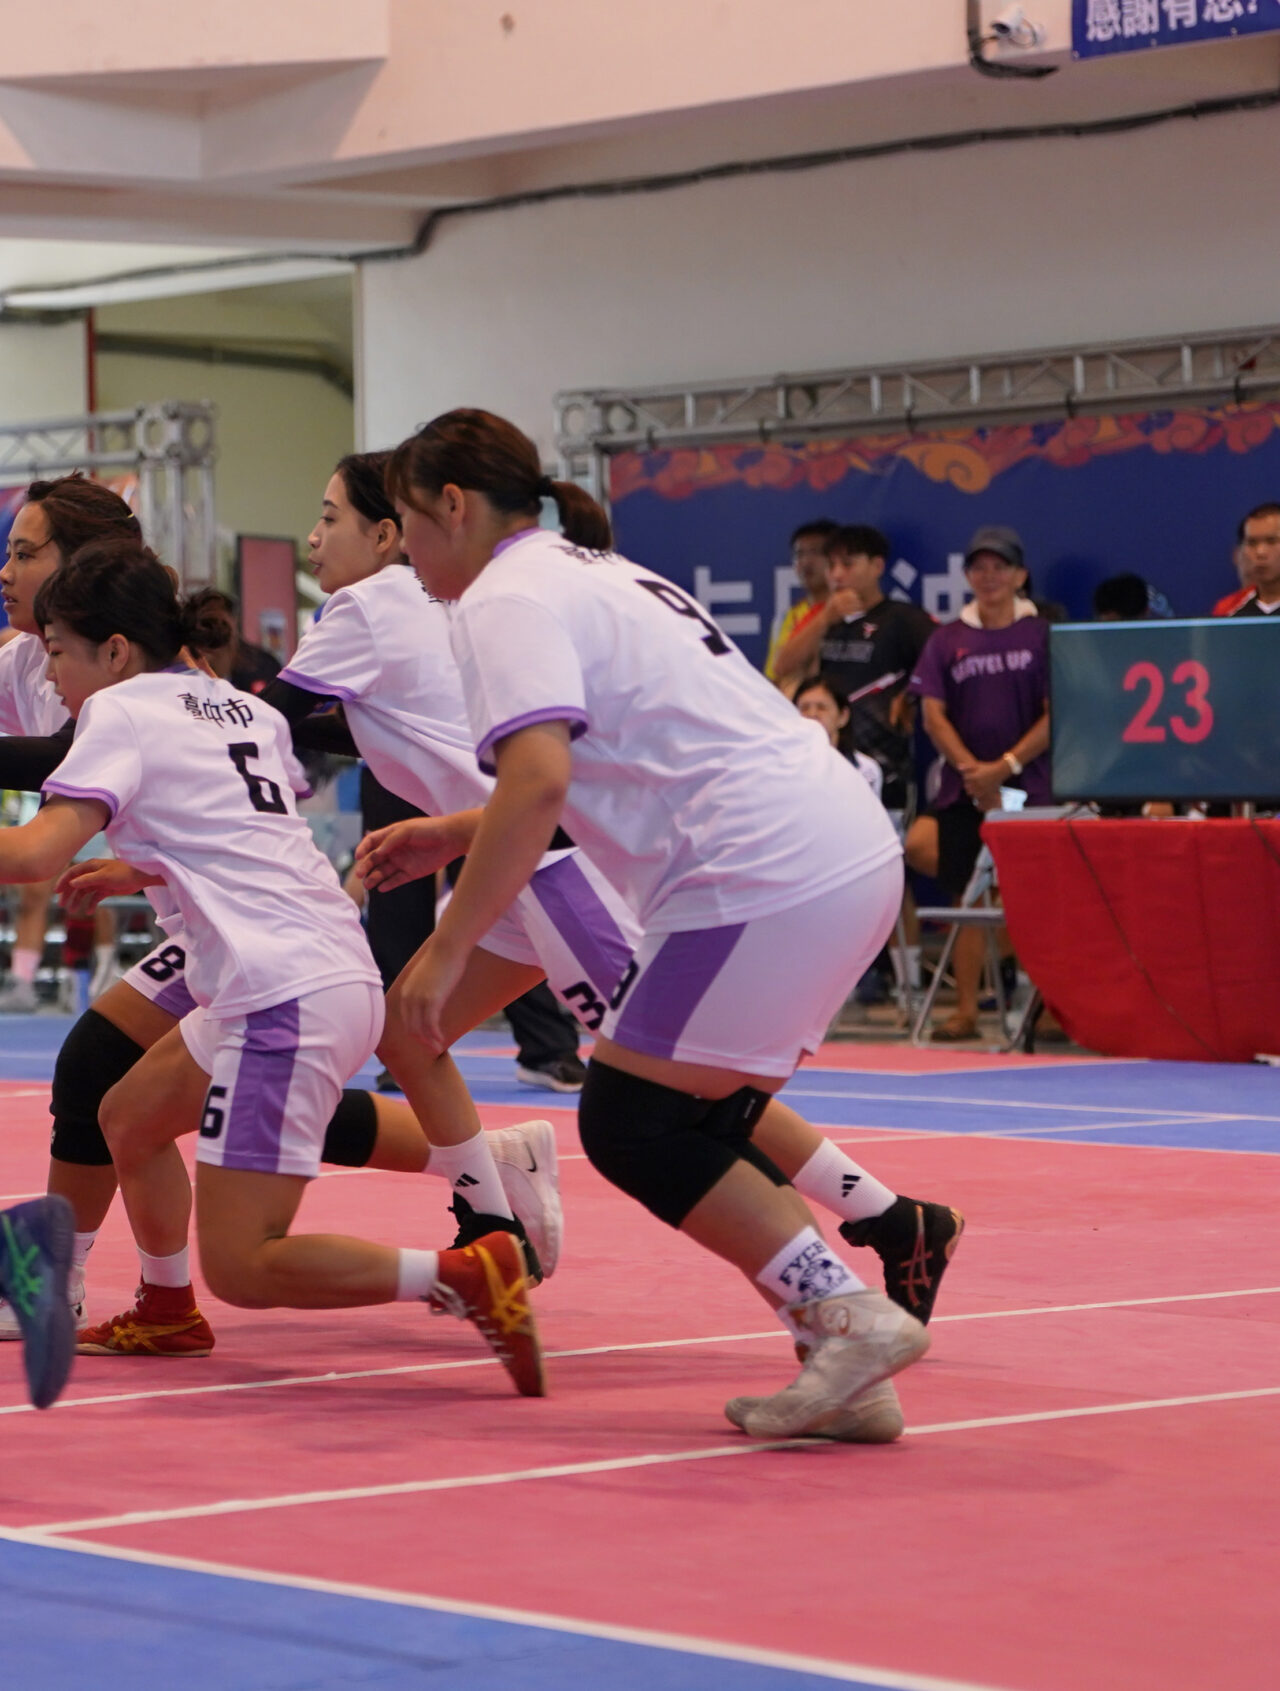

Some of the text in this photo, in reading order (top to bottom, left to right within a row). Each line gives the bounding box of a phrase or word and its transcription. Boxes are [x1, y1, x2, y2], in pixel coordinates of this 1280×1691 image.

[633, 577, 733, 657] 9
[1122, 660, 1215, 744] 23
[227, 741, 289, 815] 6
[140, 944, 186, 982] 8
[560, 980, 607, 1032] 3
[200, 1084, 228, 1140] 6
